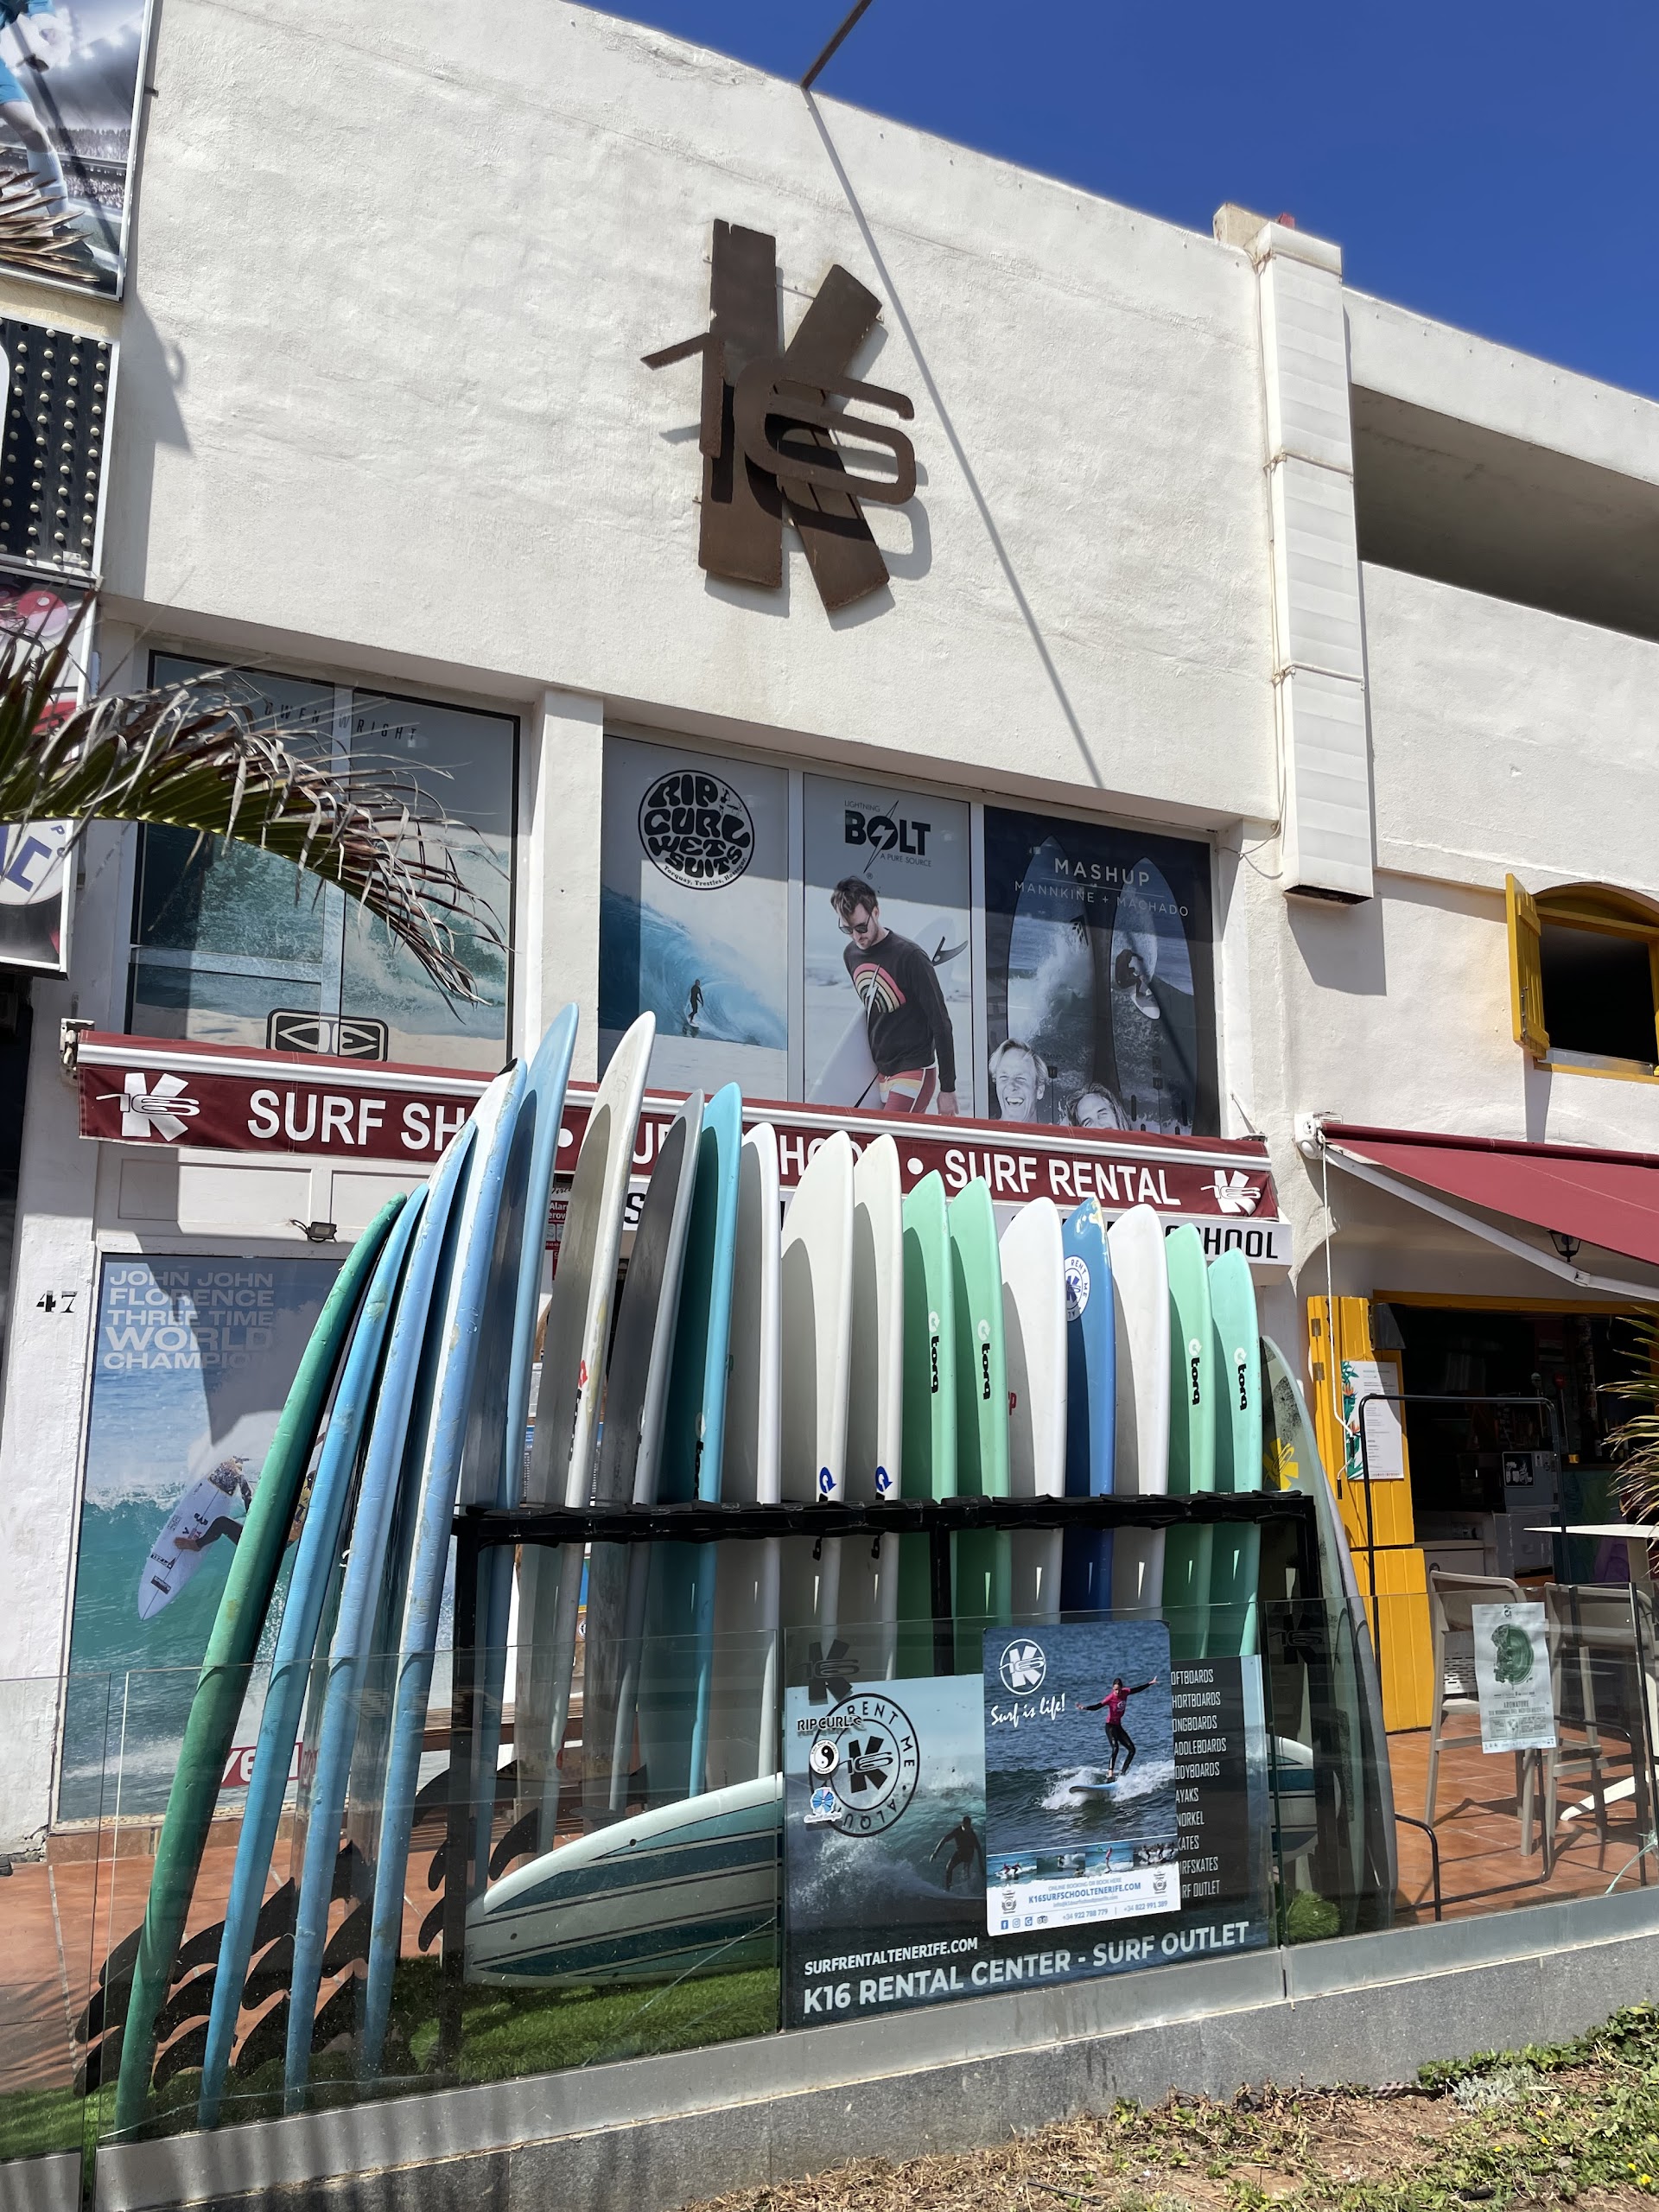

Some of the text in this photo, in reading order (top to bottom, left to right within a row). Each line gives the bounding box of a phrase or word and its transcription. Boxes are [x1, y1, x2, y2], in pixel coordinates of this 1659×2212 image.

[264, 702, 416, 741] OWEN WRIGHT
[648, 774, 718, 808] RIP
[844, 799, 880, 812] LIGHTNING
[644, 807, 751, 848] CURL
[844, 809, 931, 856] BOLT
[887, 853, 903, 863] PURE
[905, 856, 931, 868] SOURCE
[1054, 857, 1150, 887] MASHUP
[1014, 880, 1095, 904] MANNKINE
[1116, 896, 1189, 917] MACHADO
[247, 1089, 466, 1152] SURF SH
[944, 1149, 1182, 1206] SURF RENTAL
[110, 1270, 274, 1287] JOHN JOHN
[35, 1290, 78, 1313] 47
[109, 1288, 275, 1307] FLORENCE
[106, 1309, 274, 1326] THREE TIME
[105, 1326, 275, 1351] WORLD
[931, 1335, 939, 1394] torq
[982, 1343, 991, 1401] torq
[1191, 1357, 1200, 1406] torq
[1237, 1363, 1247, 1410] torq
[1171, 1669, 1214, 1686] OFTBOARDS
[990, 1693, 1065, 1728] Surf is life!
[1172, 1691, 1221, 1709] HORTBOARDS
[847, 1700, 915, 1768] RENT ME
[1172, 1715, 1217, 1732] ONGBOARDS
[1174, 1738, 1227, 1756] ADDLEBOARDS
[1175, 1762, 1220, 1780] ODYBOARDS
[1175, 1787, 1199, 1803] AYAKS
[1177, 1811, 1205, 1827] NORKEL
[1178, 1834, 1200, 1851] KATES
[1179, 1856, 1219, 1875] RFSKATES
[1028, 1882, 1141, 1904] K16SURFSCHOOLTENERIFE.COM
[1192, 1879, 1221, 1897] OUTLET
[804, 1936, 978, 1975] SURFRENTALTENERIFE.COM
[804, 1981, 851, 2014] K16
[858, 1968, 963, 2005] RENTAL
[970, 1948, 1071, 1986] CENTER
[1091, 1934, 1154, 1967] SURF
[1160, 1921, 1249, 1955] OUTLET
